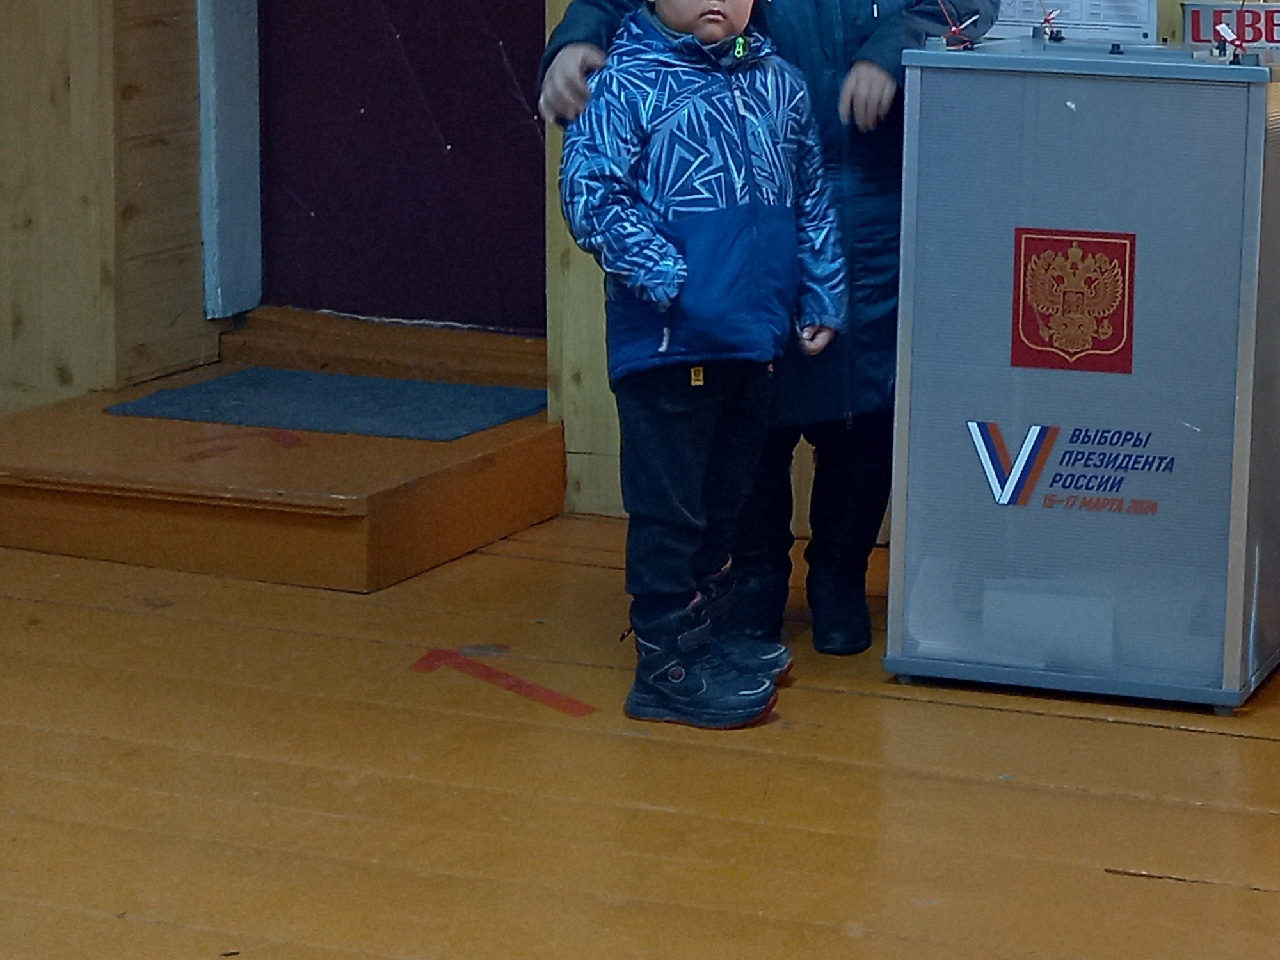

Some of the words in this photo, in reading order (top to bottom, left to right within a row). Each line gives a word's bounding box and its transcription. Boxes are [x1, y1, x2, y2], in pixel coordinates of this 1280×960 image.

[1069, 427, 1152, 449] ВЫБОРЫ
[1058, 450, 1175, 473] ПРЕЗИДЕНТА
[1049, 472, 1124, 492] РОССИИ
[1079, 496, 1124, 513] МАРТА
